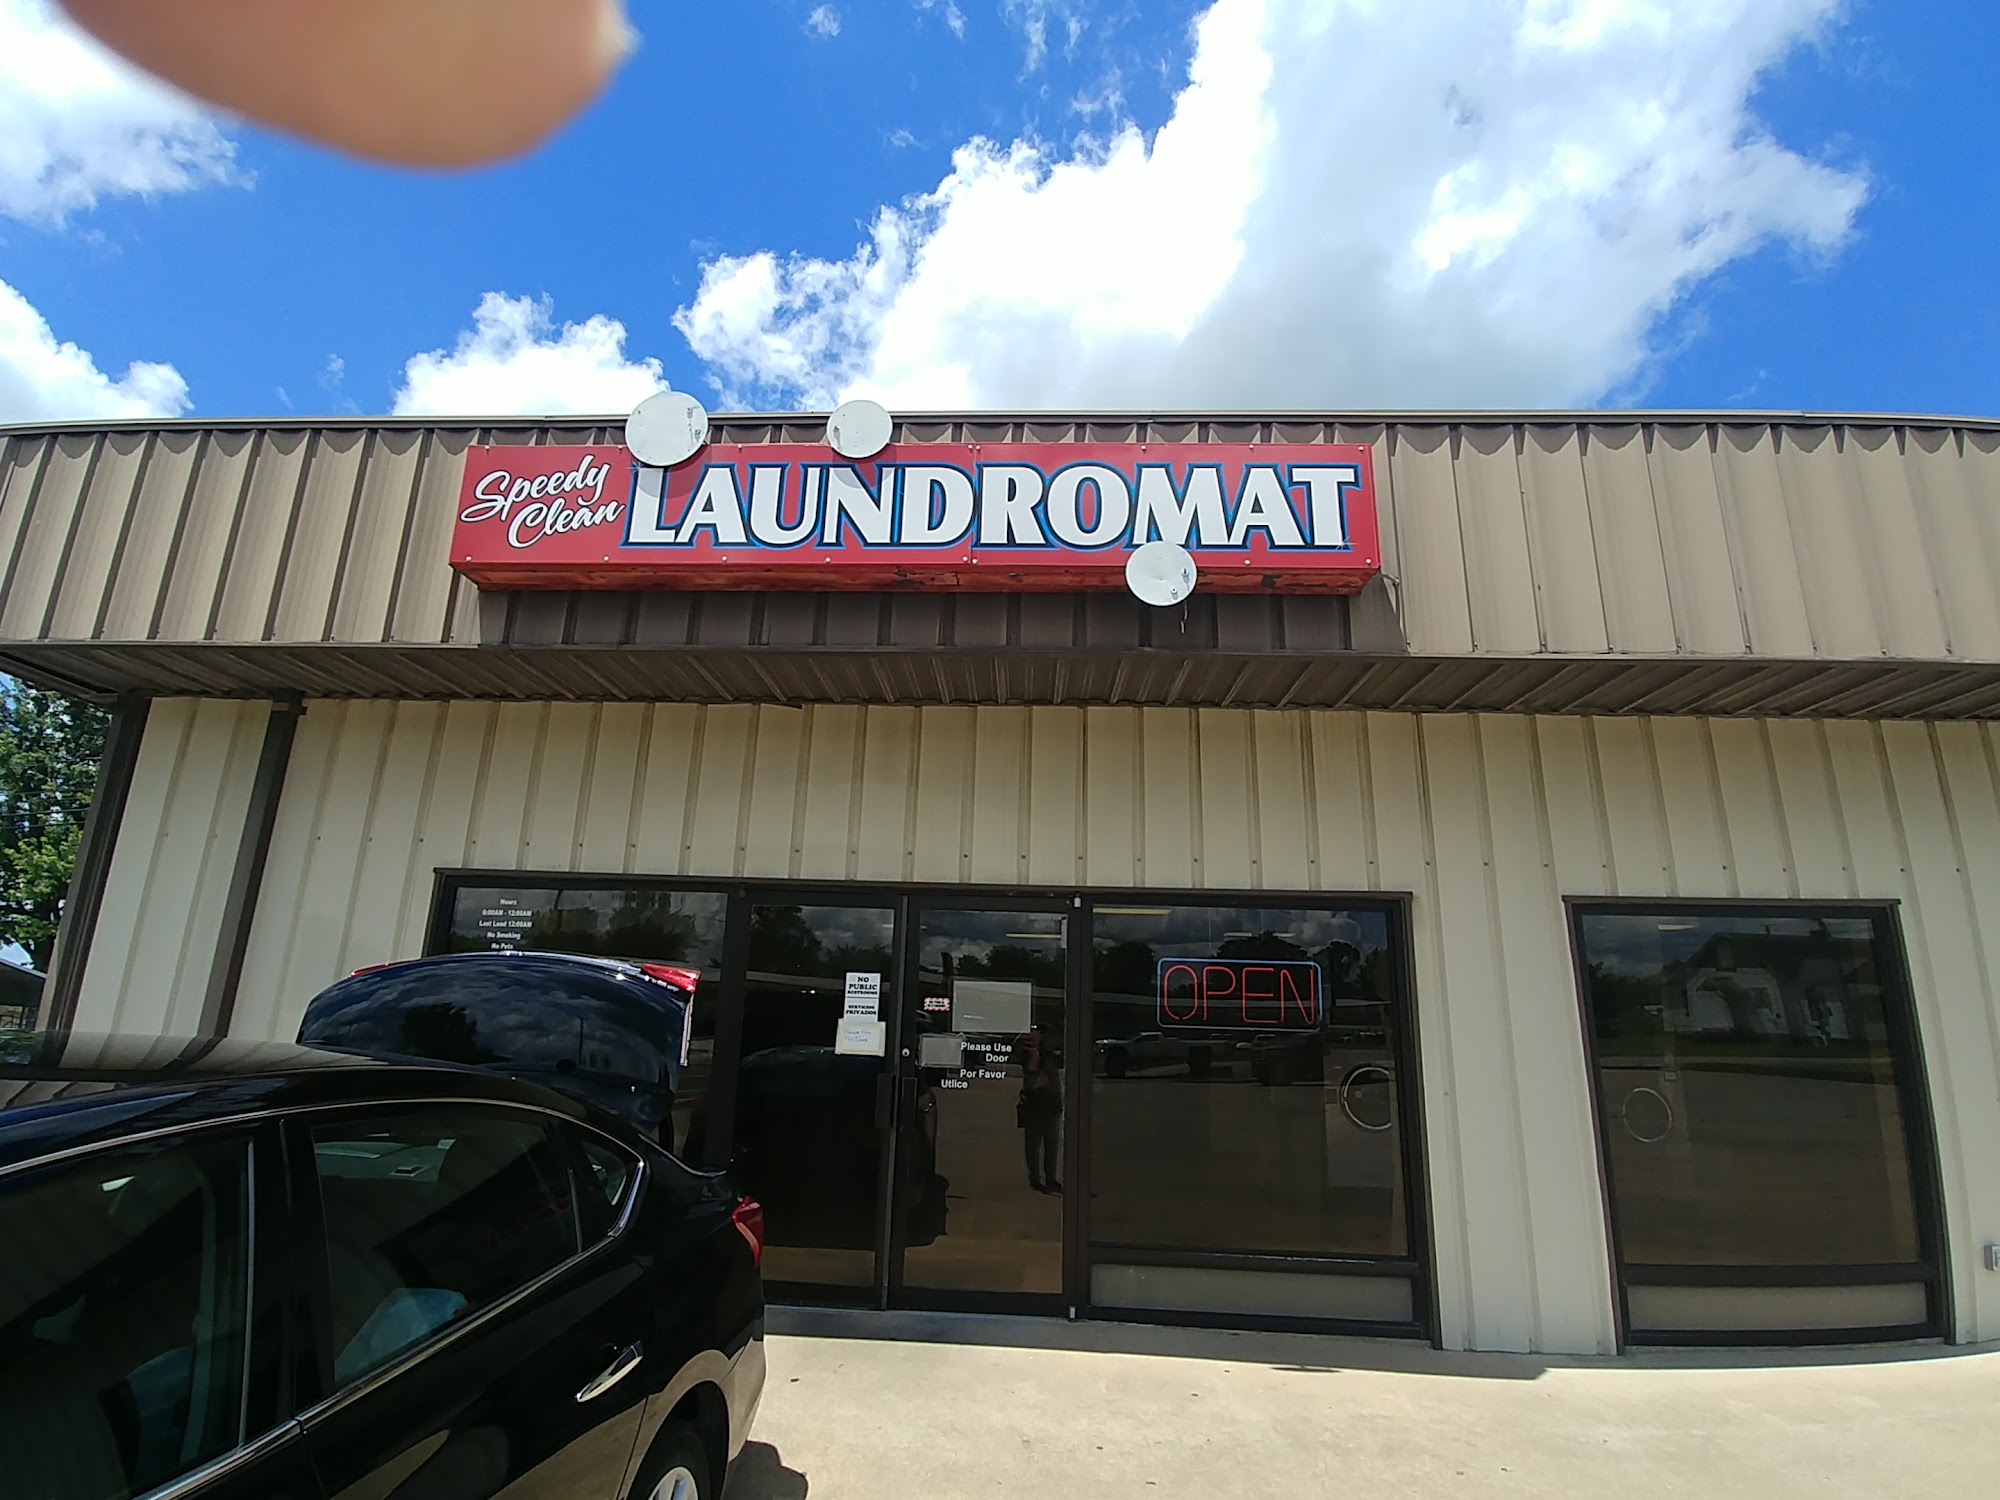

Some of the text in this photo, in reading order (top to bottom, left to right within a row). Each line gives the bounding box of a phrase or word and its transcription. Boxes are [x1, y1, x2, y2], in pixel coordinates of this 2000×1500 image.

[460, 454, 611, 522] Speedy
[620, 462, 1362, 551] LAUNDROMAT
[507, 497, 626, 548] Clean
[496, 932, 521, 940] Smoking
[1163, 964, 1315, 1025] OPEN
[960, 1041, 1012, 1052] Please Use
[985, 1053, 1009, 1062] Door
[960, 1069, 1006, 1079] Por Favor
